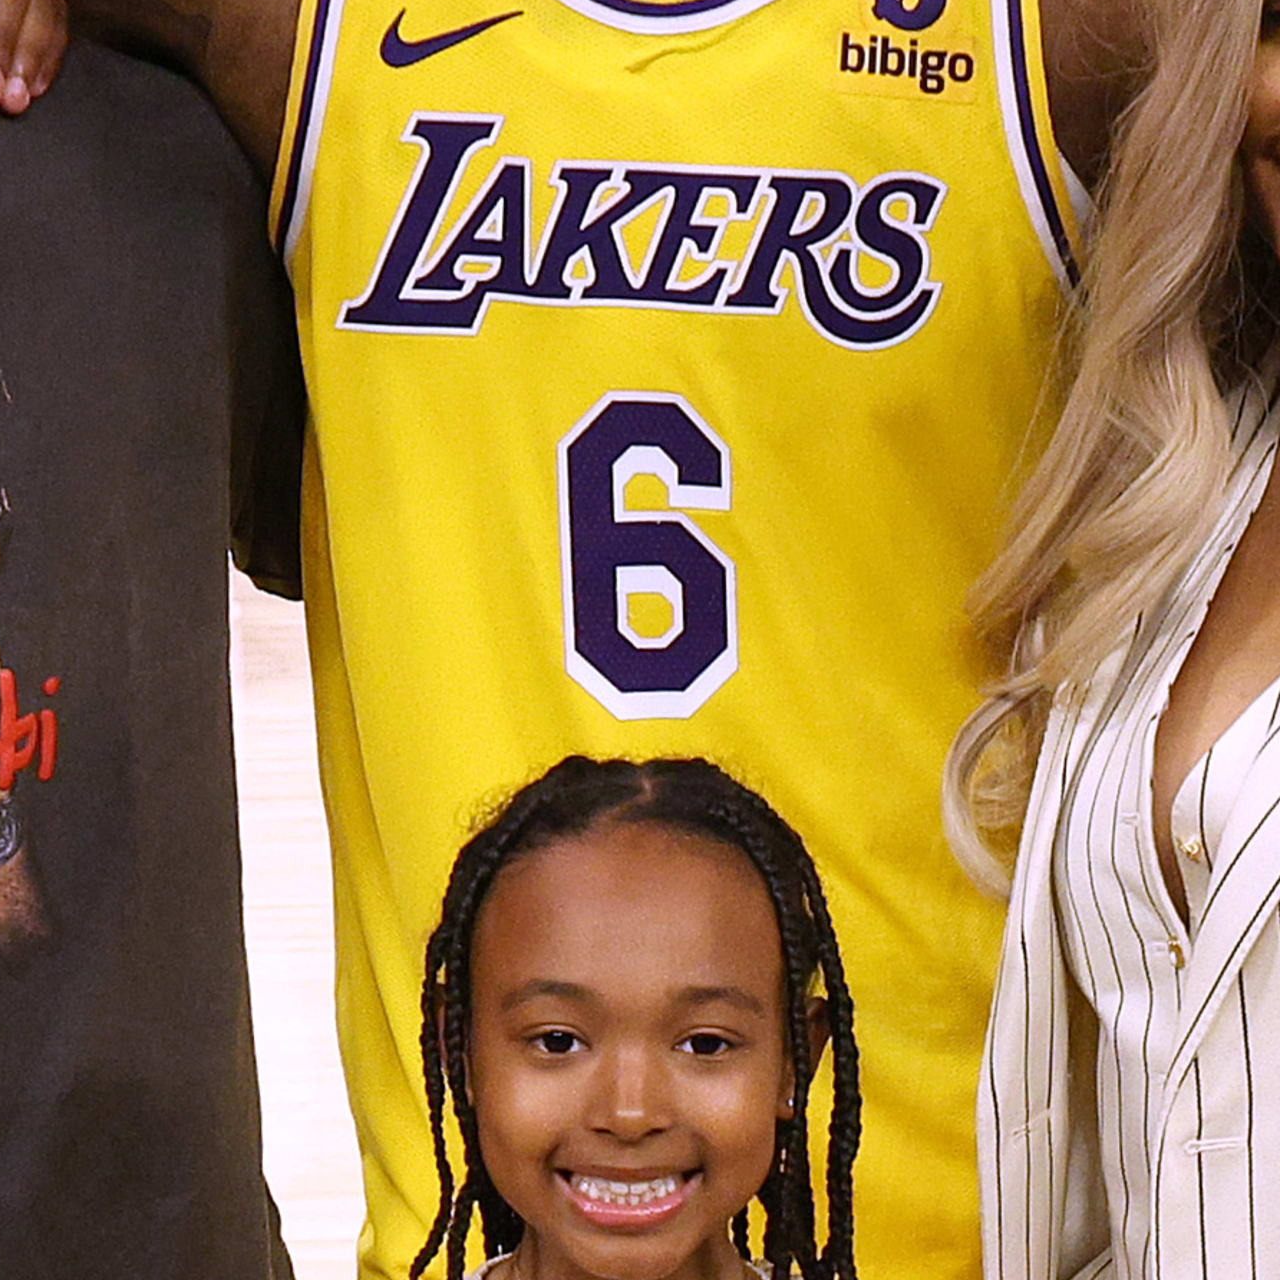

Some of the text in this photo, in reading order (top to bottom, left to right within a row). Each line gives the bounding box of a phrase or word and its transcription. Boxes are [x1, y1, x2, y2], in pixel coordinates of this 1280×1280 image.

[840, 32, 975, 95] bibigo
[336, 111, 949, 351] LAKERS
[556, 389, 740, 722] 6
